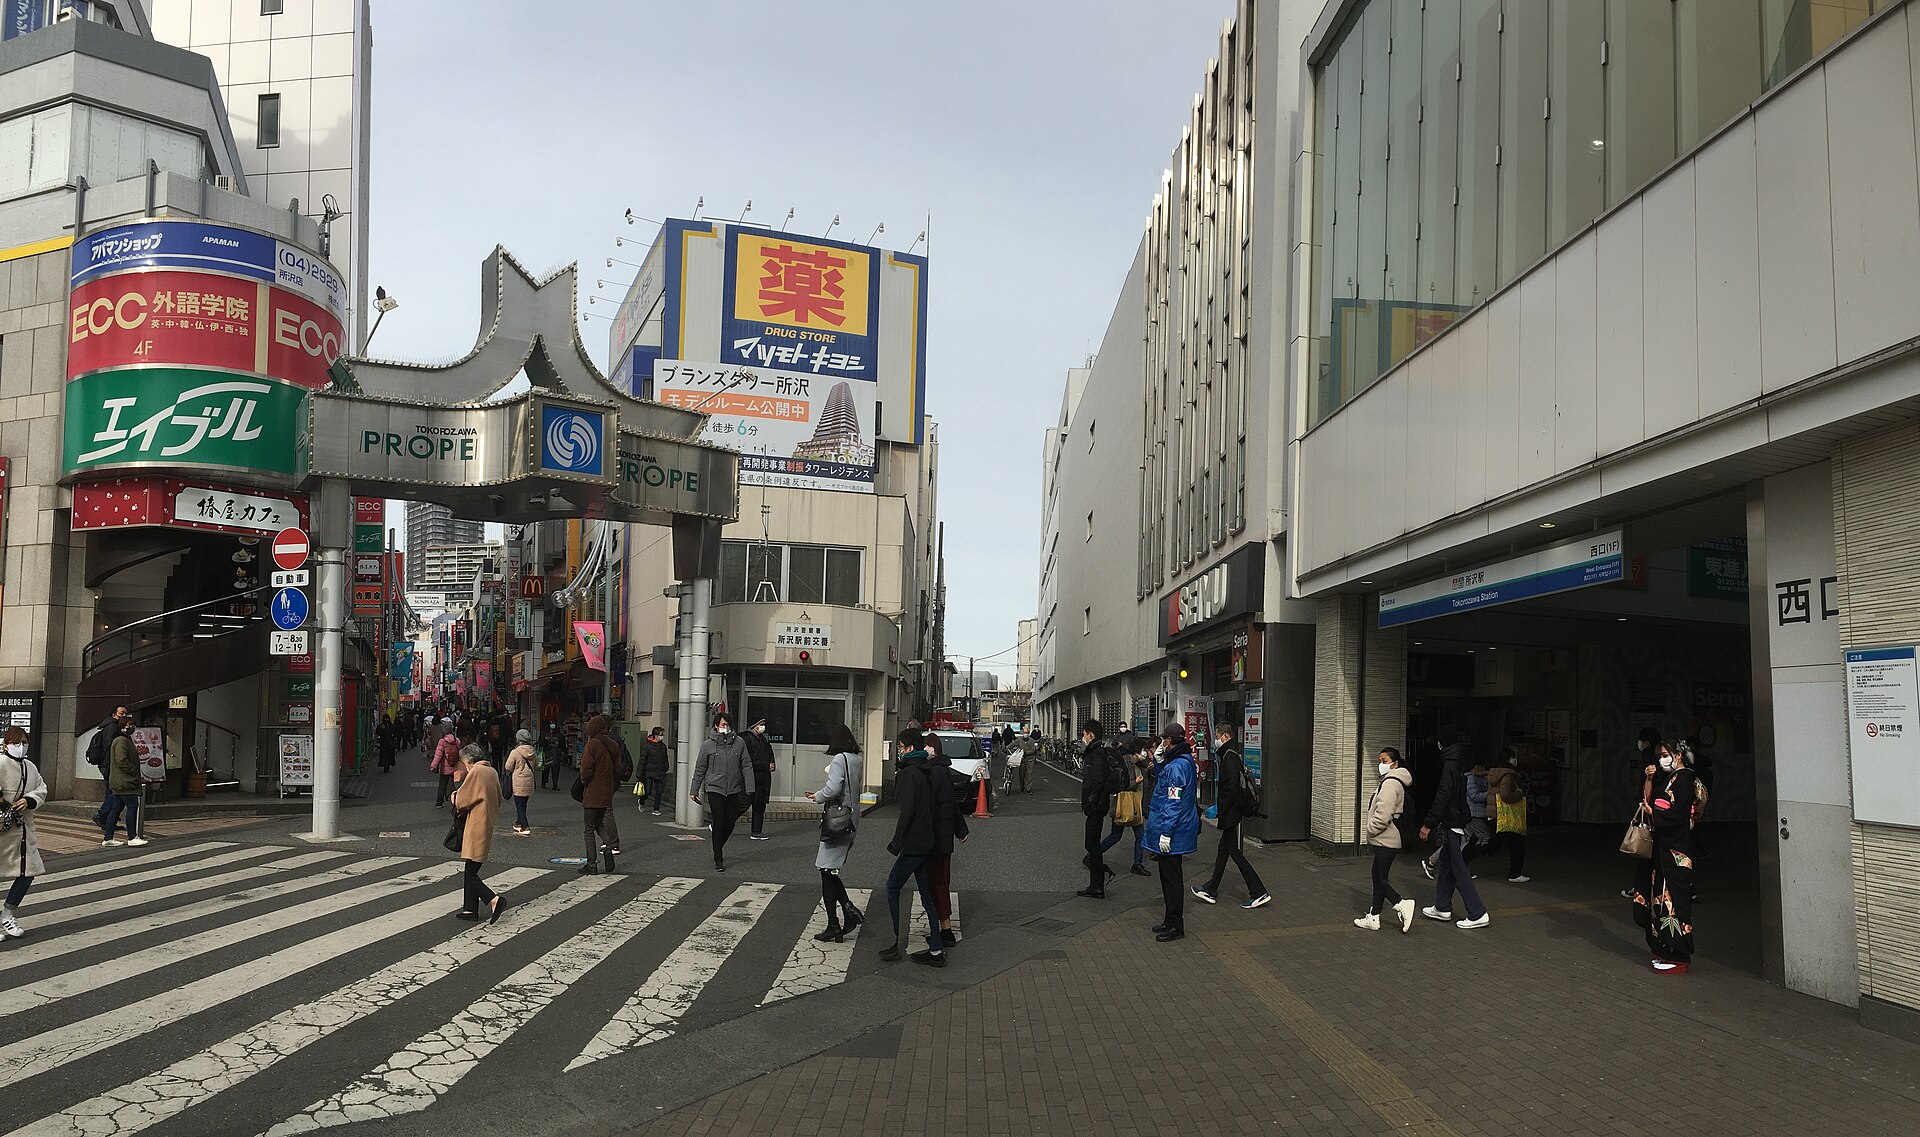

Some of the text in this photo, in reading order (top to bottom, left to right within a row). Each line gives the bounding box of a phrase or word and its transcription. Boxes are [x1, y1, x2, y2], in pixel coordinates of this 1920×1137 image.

[91, 232, 163, 262] アパマンショップ
[202, 236, 240, 248] APAMAN
[279, 268, 304, 287] 所沢店
[758, 244, 848, 327] 薬
[151, 290, 250, 323] 外語学院
[71, 291, 148, 344] ECC
[764, 326, 837, 345] DRUG STORE
[133, 340, 154, 356] 4F
[732, 335, 866, 373] マツモトキヨシ
[76, 381, 272, 465] エイブル
[415, 425, 478, 436] TOKOROZAWA
[364, 430, 474, 461] PROPE
[619, 450, 658, 464] KOROZAWA
[357, 501, 381, 511] ECC
[1589, 539, 1620, 558] 西口(1F)
[275, 573, 305, 585] 自動車
[1464, 571, 1485, 587] 所沢駅
[1452, 590, 1499, 608] Tokorozawa Station
[777, 635, 829, 647] 所沢駅前交番
[1233, 631, 1249, 649] Seria
[290, 655, 312, 664] ECC
[1879, 724, 1903, 733] 終日禁煙
